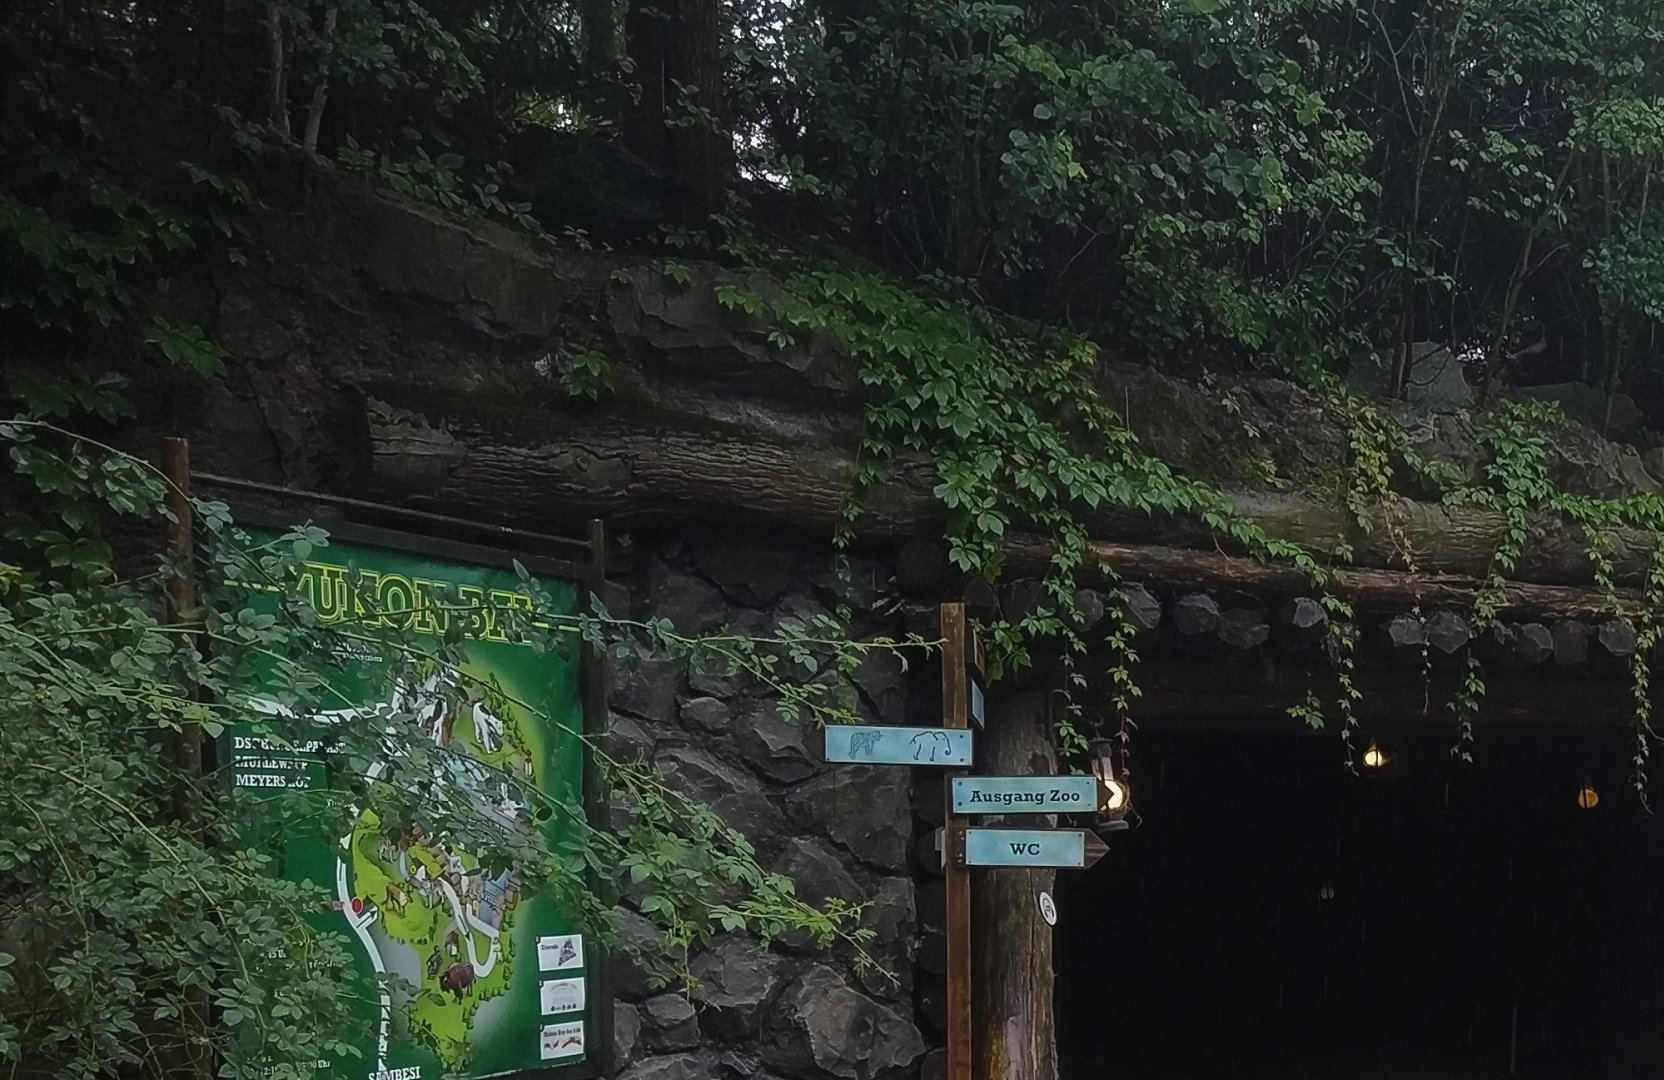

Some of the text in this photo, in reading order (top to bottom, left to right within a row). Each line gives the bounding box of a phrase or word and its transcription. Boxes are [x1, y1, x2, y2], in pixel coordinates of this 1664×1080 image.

[235, 775, 286, 788] MEYERS
[969, 789, 1081, 806] Ausgang Zoo
[1009, 843, 1041, 856] WC
